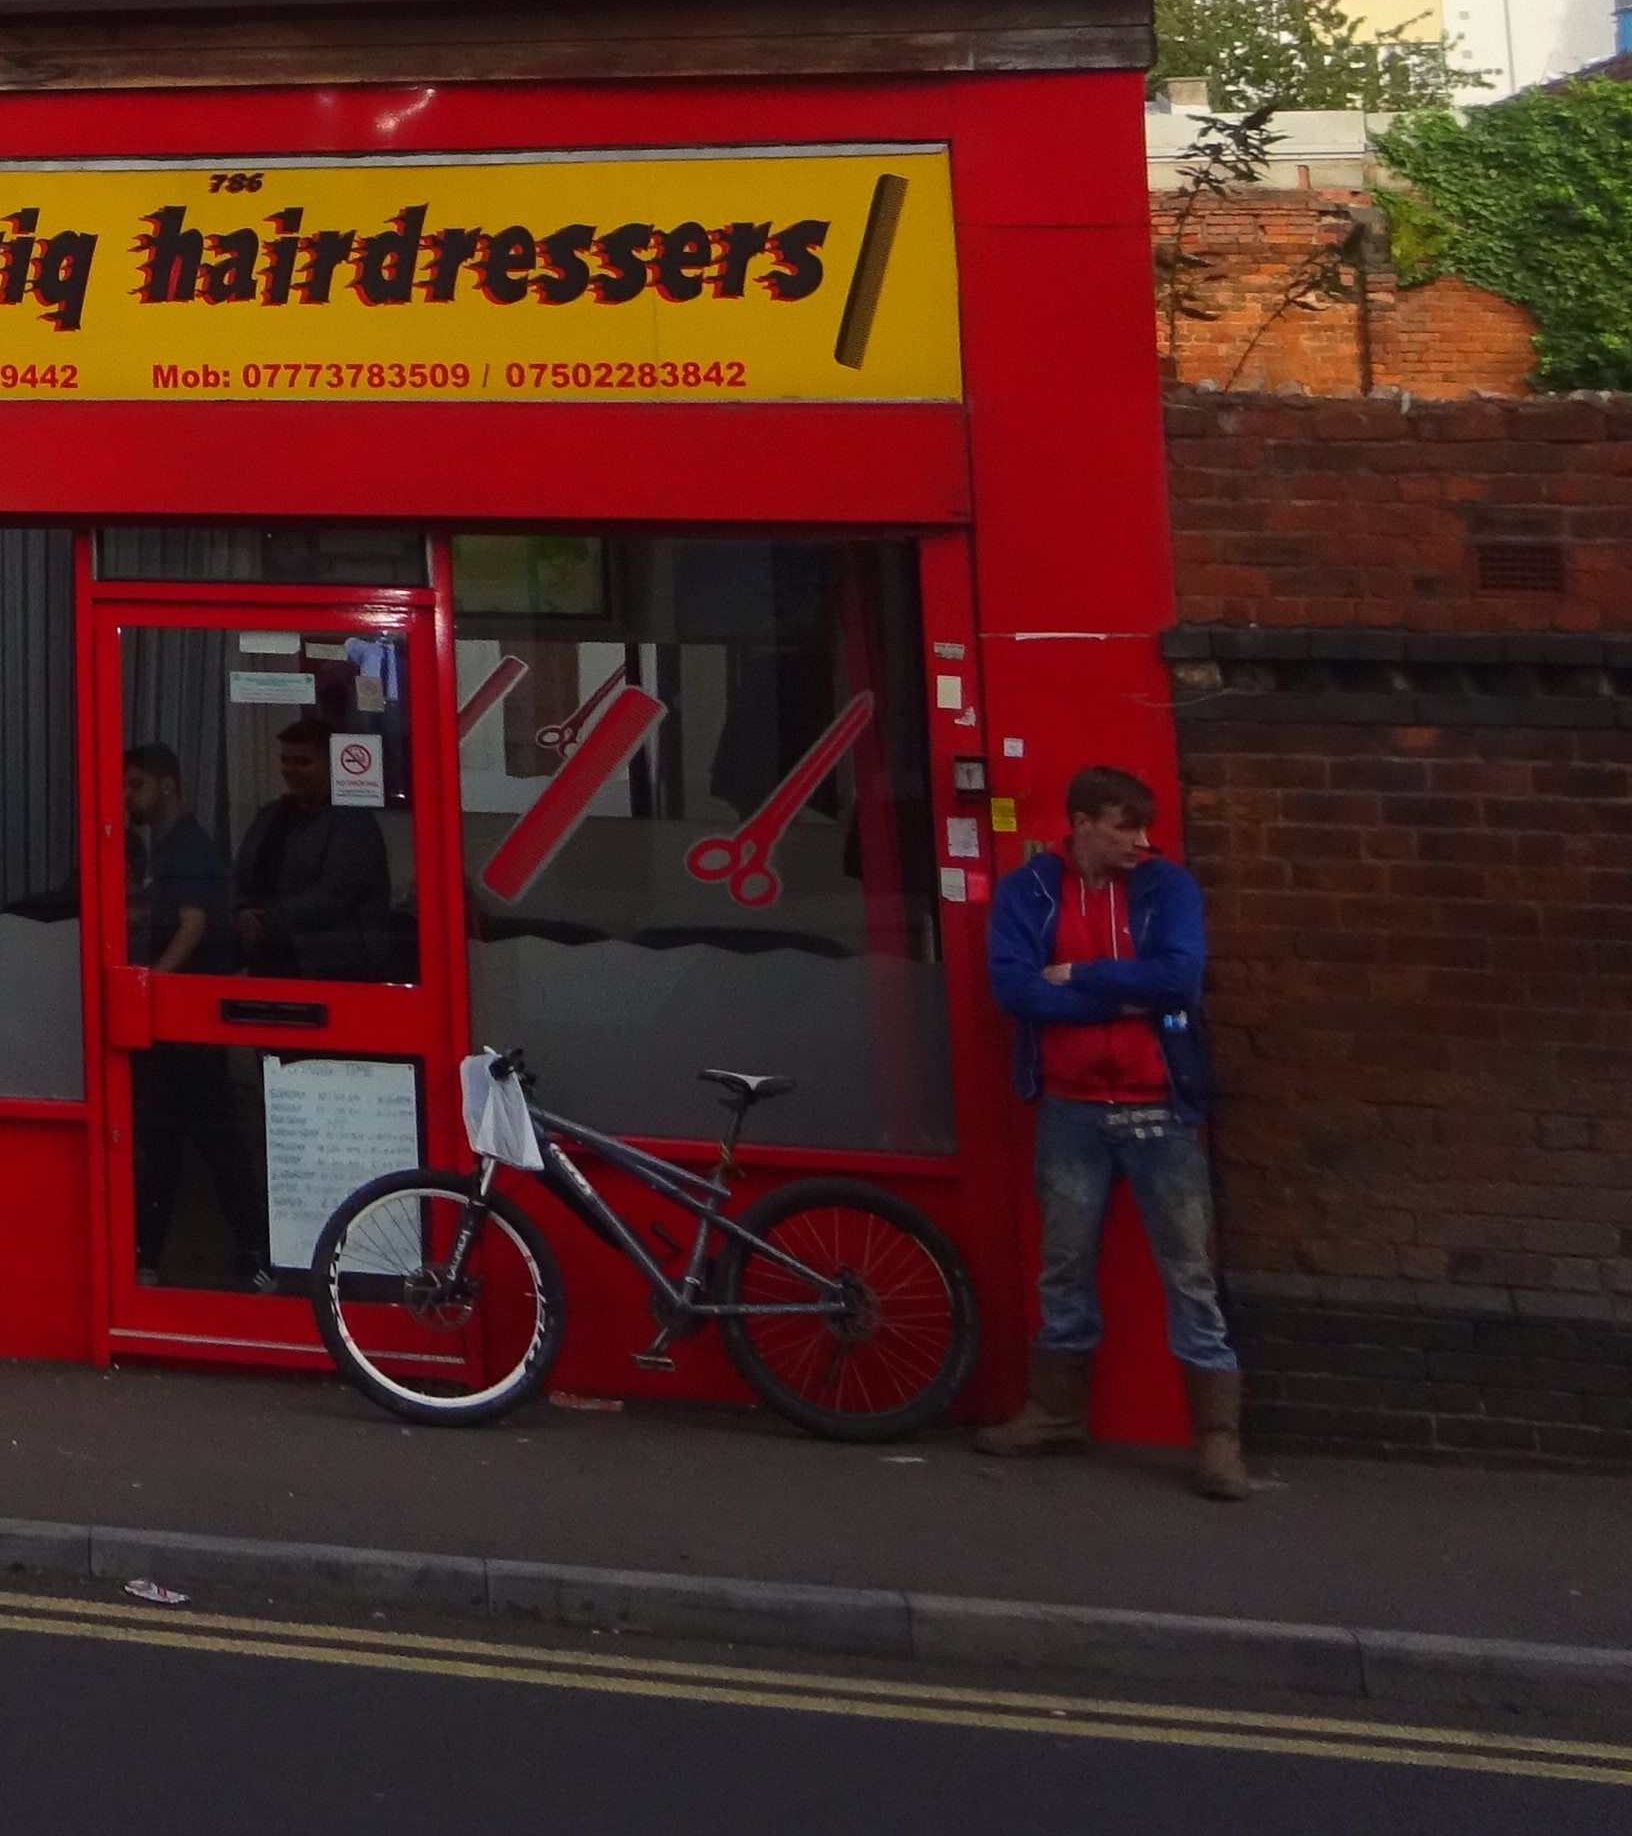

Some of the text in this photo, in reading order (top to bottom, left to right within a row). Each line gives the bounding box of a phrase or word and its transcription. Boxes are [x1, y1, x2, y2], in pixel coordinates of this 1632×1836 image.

[208, 173, 266, 194] 786
[129, 203, 831, 307] hairdressers
[152, 364, 230, 389] Mob:
[242, 363, 470, 390] 07773783509
[482, 363, 490, 389] /
[506, 361, 746, 389] 07502283842
